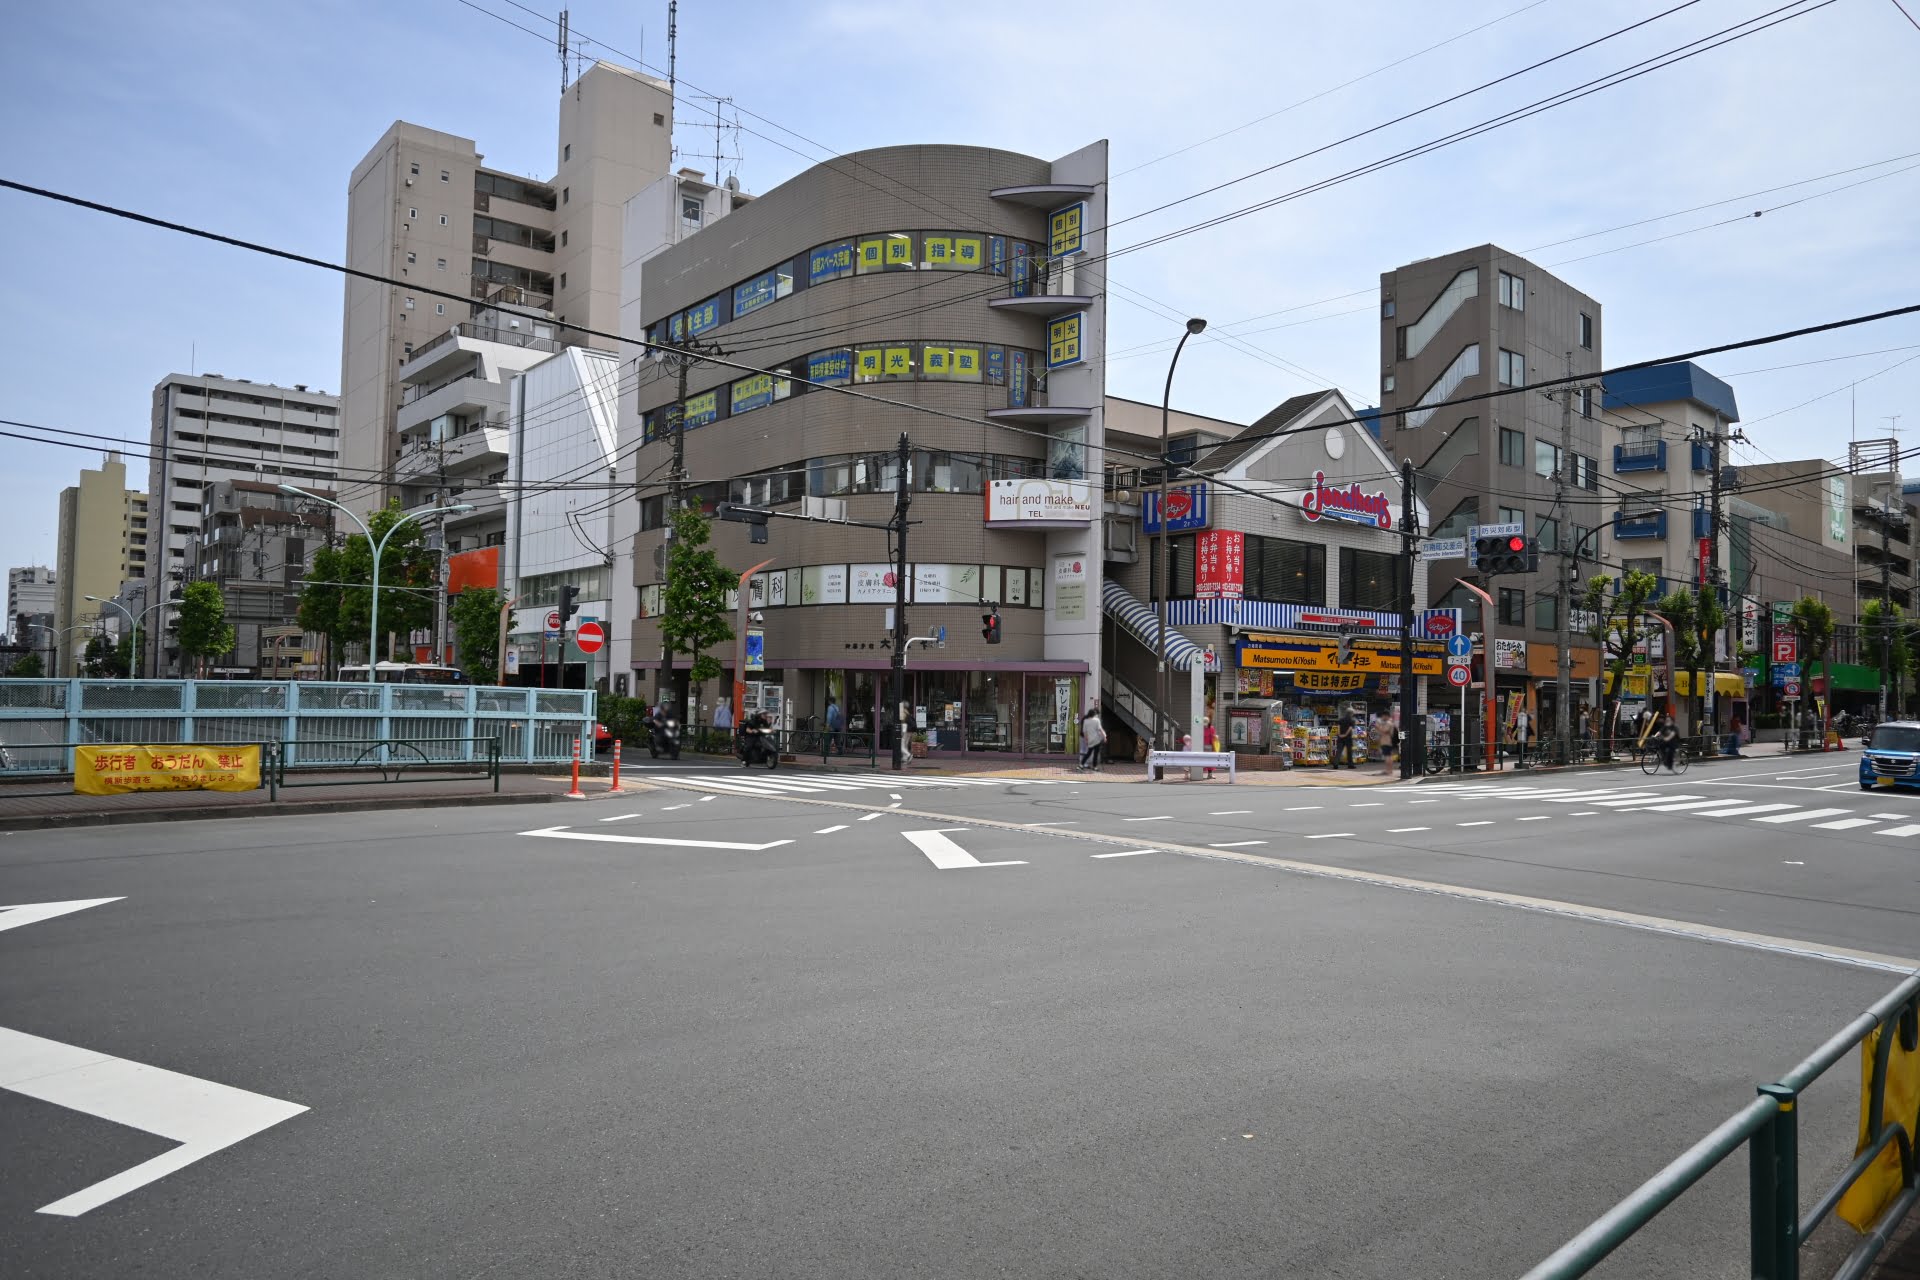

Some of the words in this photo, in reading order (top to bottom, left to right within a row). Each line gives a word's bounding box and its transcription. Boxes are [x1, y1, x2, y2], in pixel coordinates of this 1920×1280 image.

[865, 244, 975, 261] 個別指導
[1053, 323, 1076, 339] 明光
[1053, 344, 1076, 359] 義塾
[863, 354, 973, 370] 明光義塾
[999, 494, 1020, 506] hair
[1022, 494, 1042, 505] and
[1044, 494, 1074, 505] make
[1028, 510, 1043, 518] TEL
[1481, 525, 1521, 535] 防災対応型
[1422, 540, 1463, 552] 方南町交差点
[1210, 533, 1218, 573] お弁当を
[1225, 536, 1233, 582] お持ち帰り
[1200, 537, 1208, 583] お持ち帰り
[857, 579, 881, 587] 皮膚科
[857, 587, 897, 595] カメリアクリニッ
[1495, 640, 1522, 651] おたからや
[1777, 644, 1792, 660] P
[1253, 654, 1292, 664] Matsumoto
[1300, 673, 1360, 688] 本日は特売日
[1453, 670, 1467, 681] 40
[95, 755, 136, 771] 歩行者
[151, 754, 205, 770] おうだん
[217, 754, 244, 769] 禁止
[104, 775, 151, 785] 横断歩道を
[171, 773, 236, 784] わたりましょう
